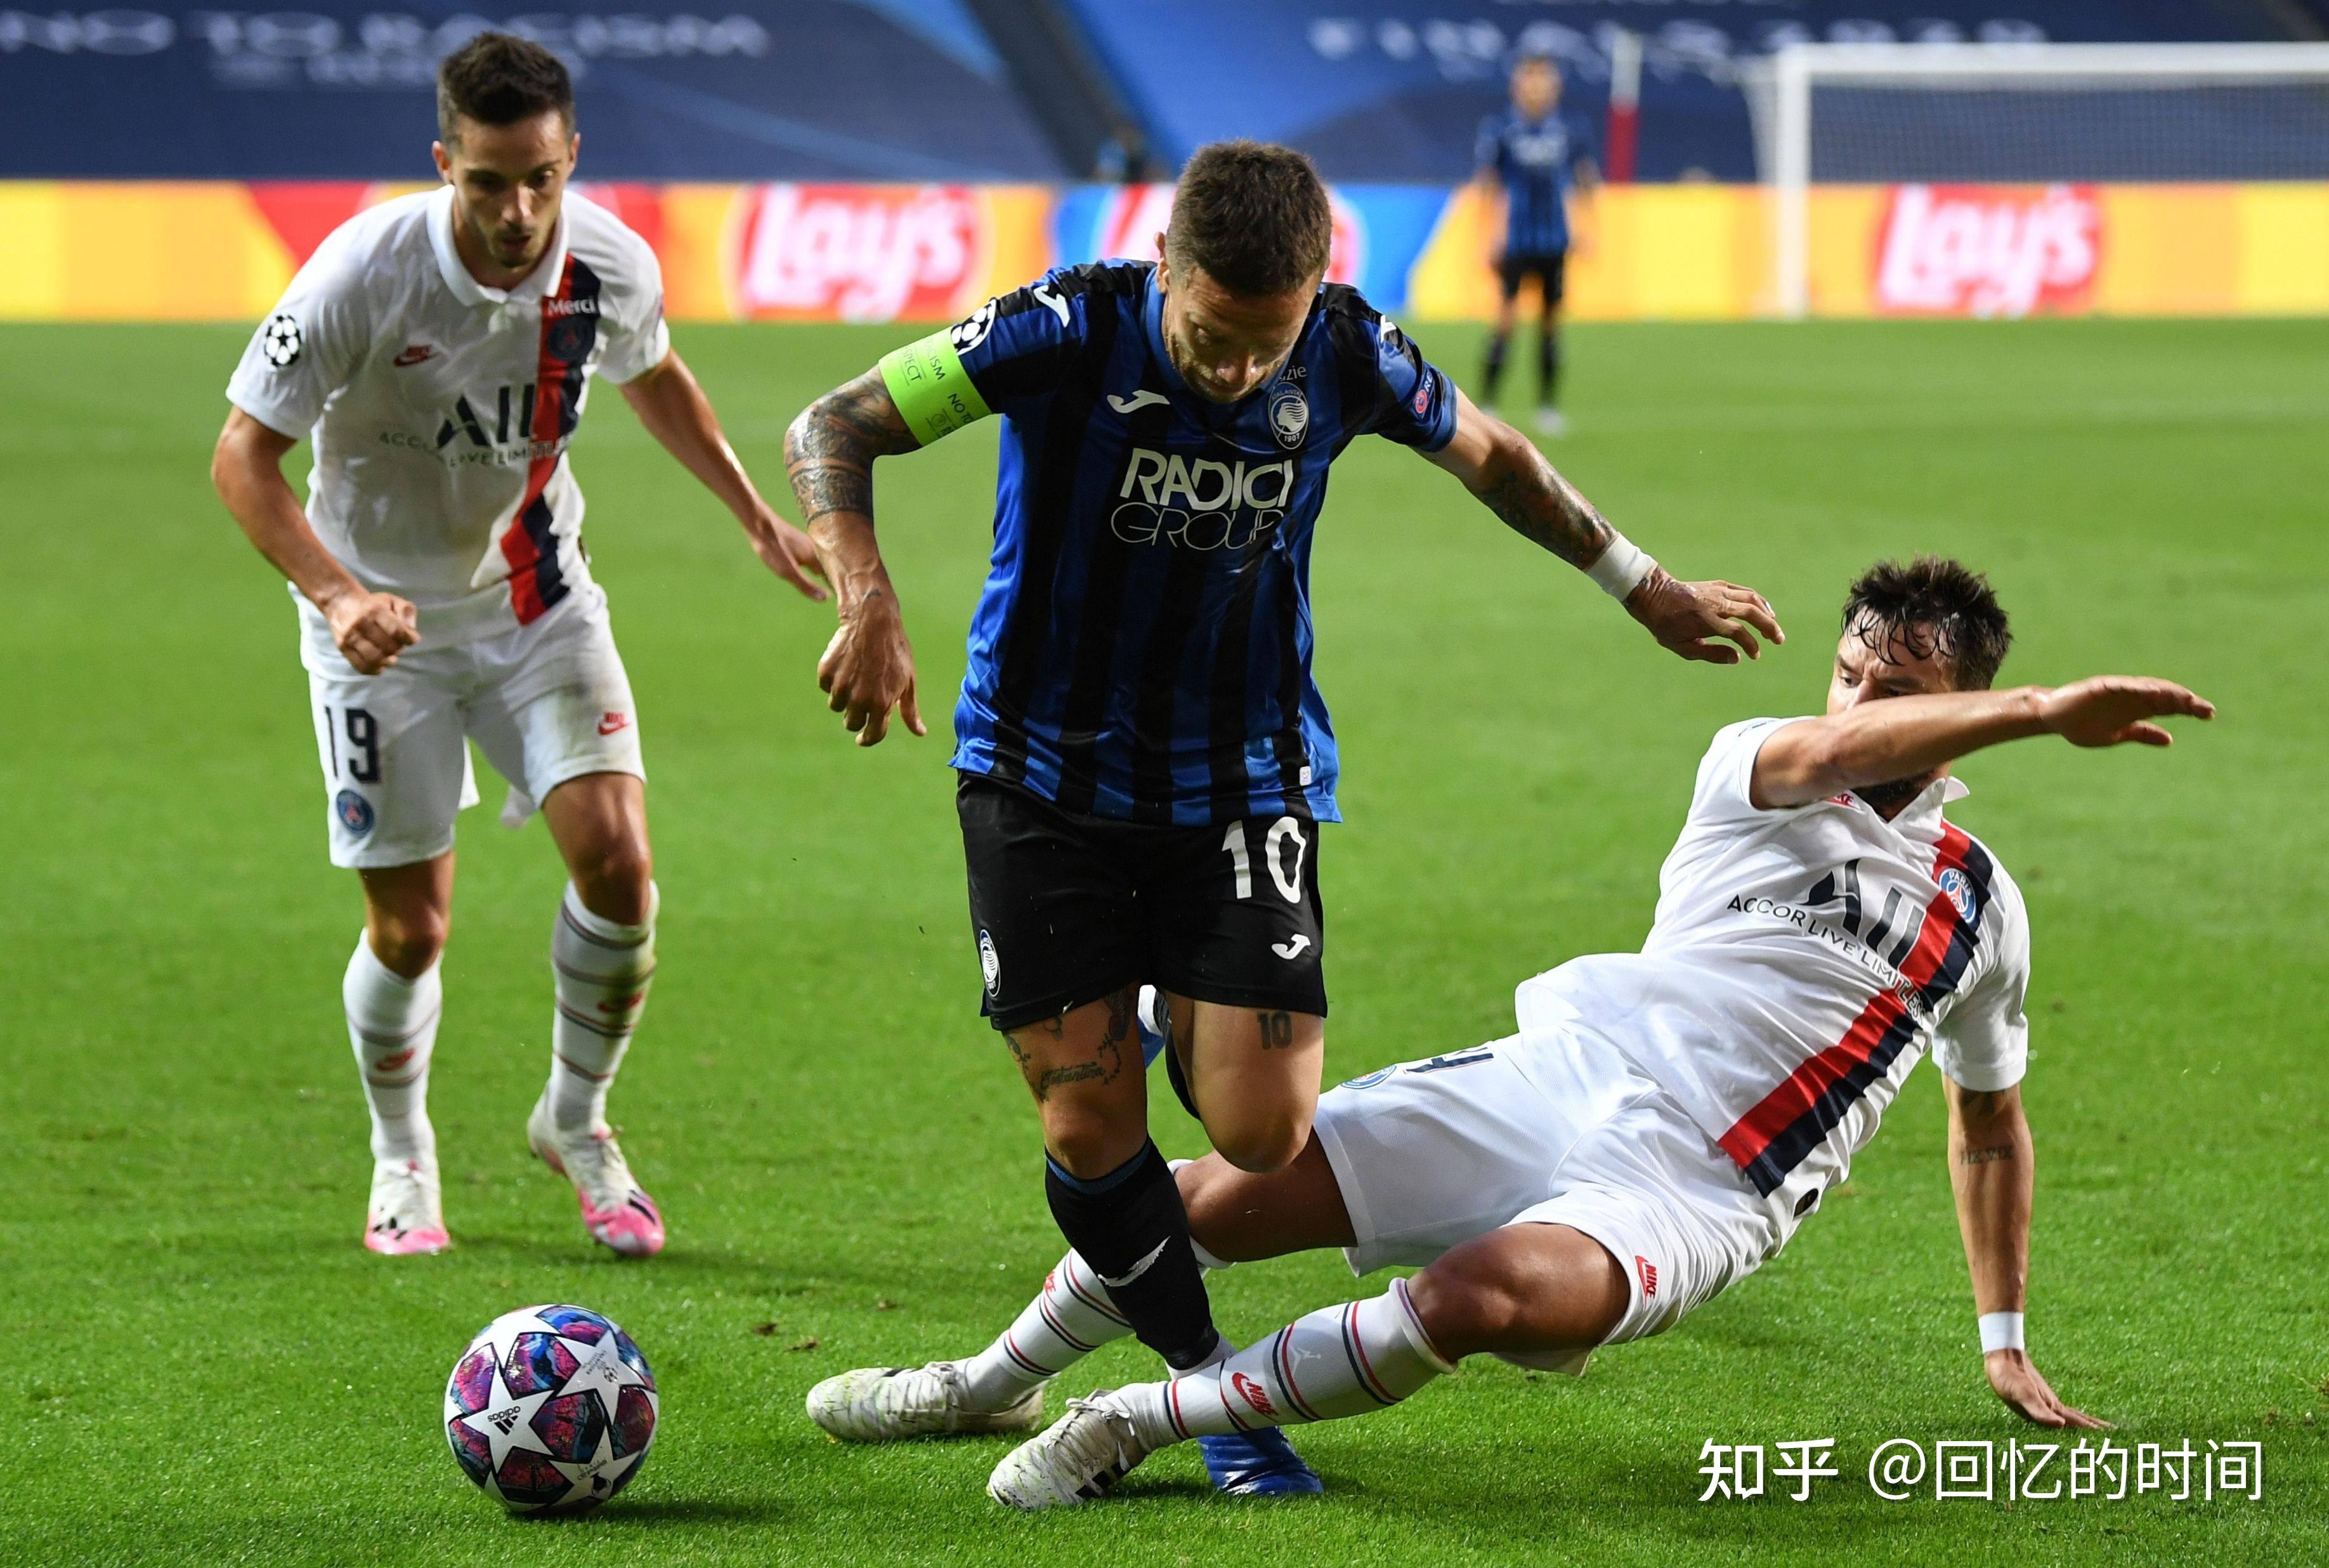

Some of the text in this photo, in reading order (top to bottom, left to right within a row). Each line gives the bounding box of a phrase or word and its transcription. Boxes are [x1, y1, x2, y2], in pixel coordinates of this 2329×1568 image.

[547, 297, 596, 317] Merci
[947, 392, 965, 414] NO
[1119, 447, 1293, 511] RADICI
[1111, 502, 1284, 551] GROUP
[325, 705, 379, 781] 19
[1222, 816, 1307, 904] 10
[1726, 894, 1806, 927] ACCOR
[1808, 919, 1856, 957] LIVE
[1256, 1010, 1293, 1050] 10
[1645, 1263, 1657, 1300] NIKE
[487, 1405, 521, 1422] adidas
